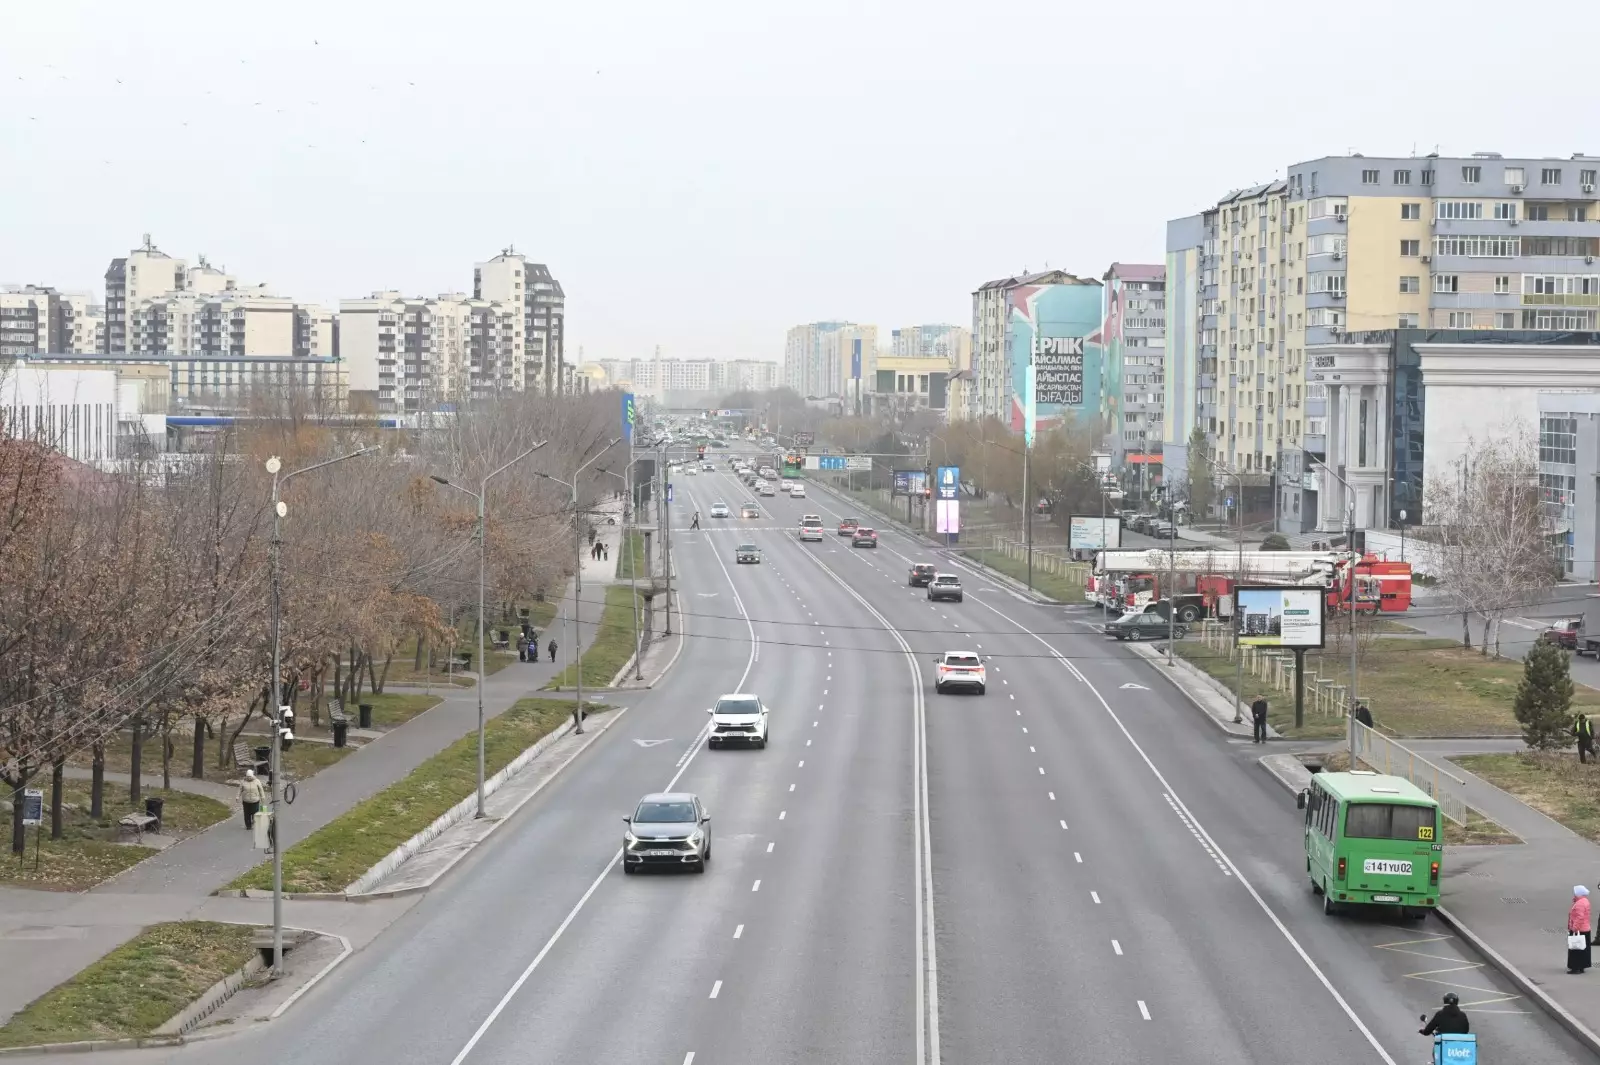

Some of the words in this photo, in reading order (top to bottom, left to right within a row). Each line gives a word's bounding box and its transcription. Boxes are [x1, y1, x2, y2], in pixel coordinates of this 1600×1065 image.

[1035, 354, 1082, 365] АЙСАЛМАС
[1036, 372, 1082, 383] АЙЫСПАС
[1420, 828, 1432, 838] 122
[1371, 862, 1387, 871] 141
[1389, 864, 1399, 872] YU
[1401, 863, 1412, 873] 02
[1447, 1048, 1471, 1058] Wolt
